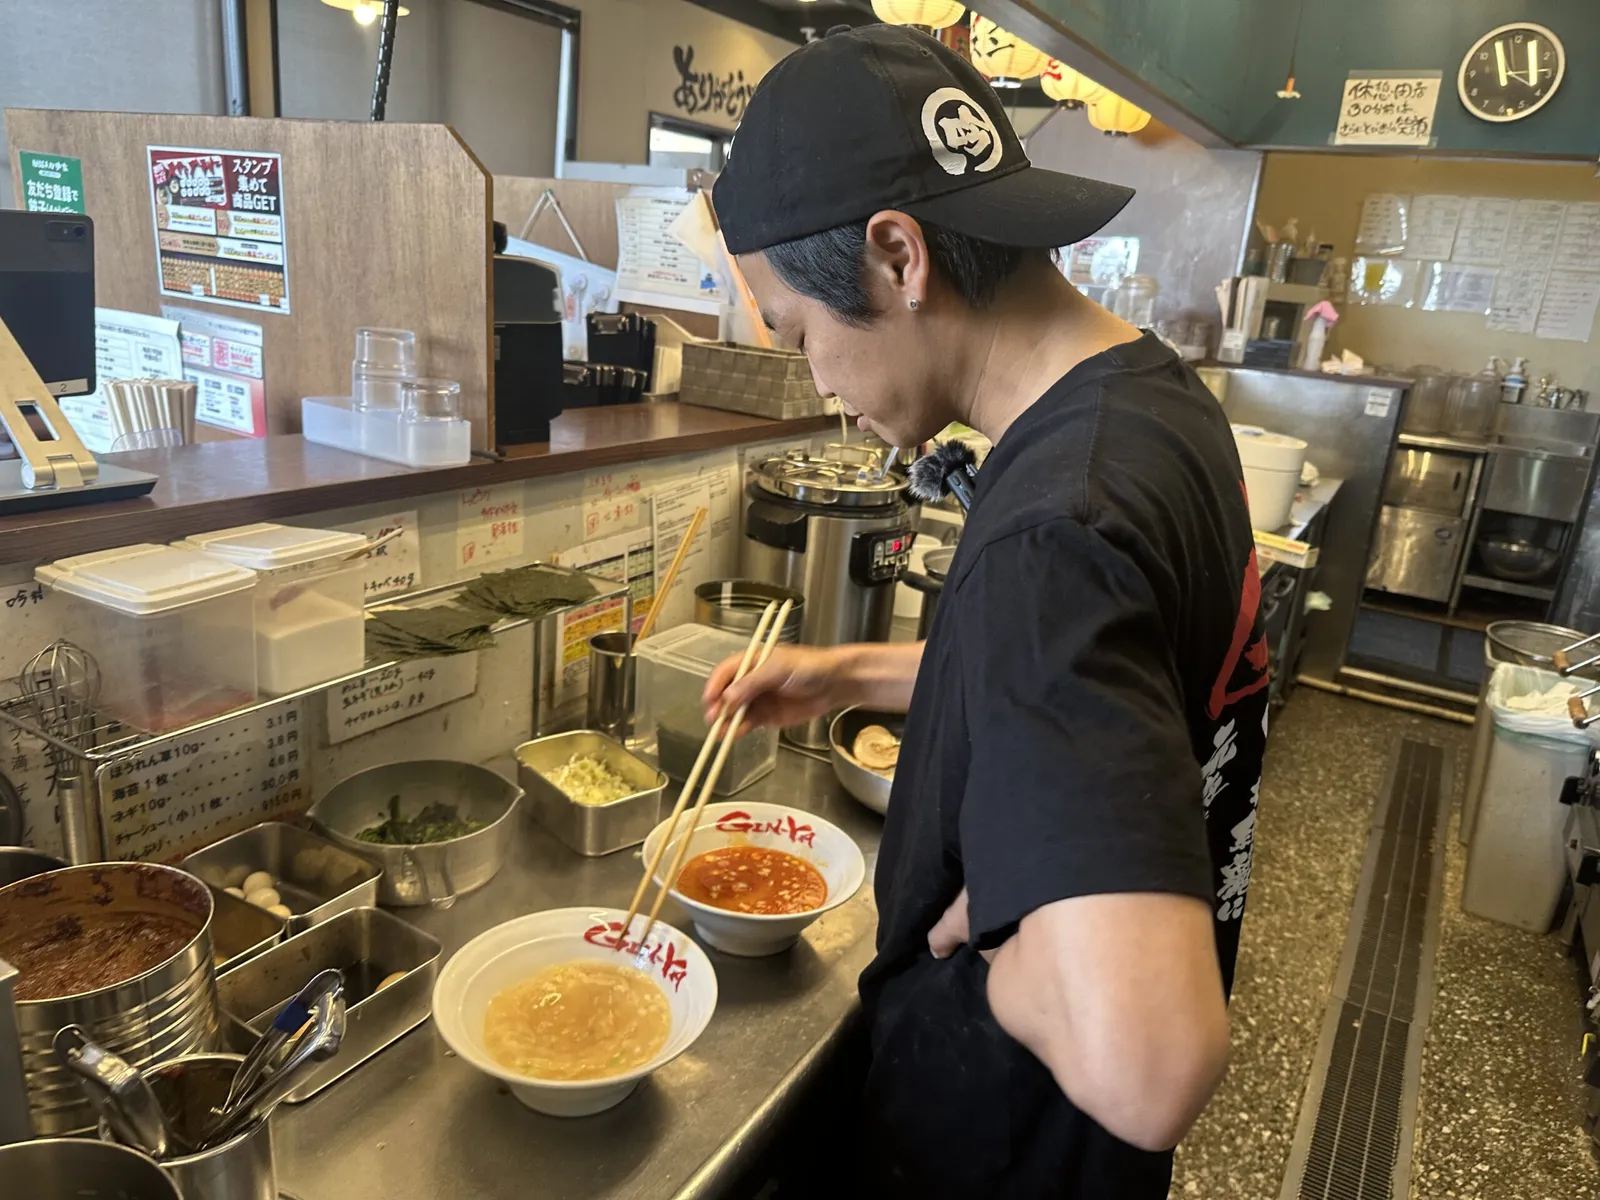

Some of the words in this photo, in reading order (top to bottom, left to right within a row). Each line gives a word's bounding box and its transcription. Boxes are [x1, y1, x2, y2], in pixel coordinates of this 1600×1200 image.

[233, 158, 274, 175] スタンプ
[27, 179, 79, 202] 友だち登録で
[238, 175, 268, 193] 集めて
[232, 192, 277, 211] 商品GET
[60, 383, 68, 392] 2
